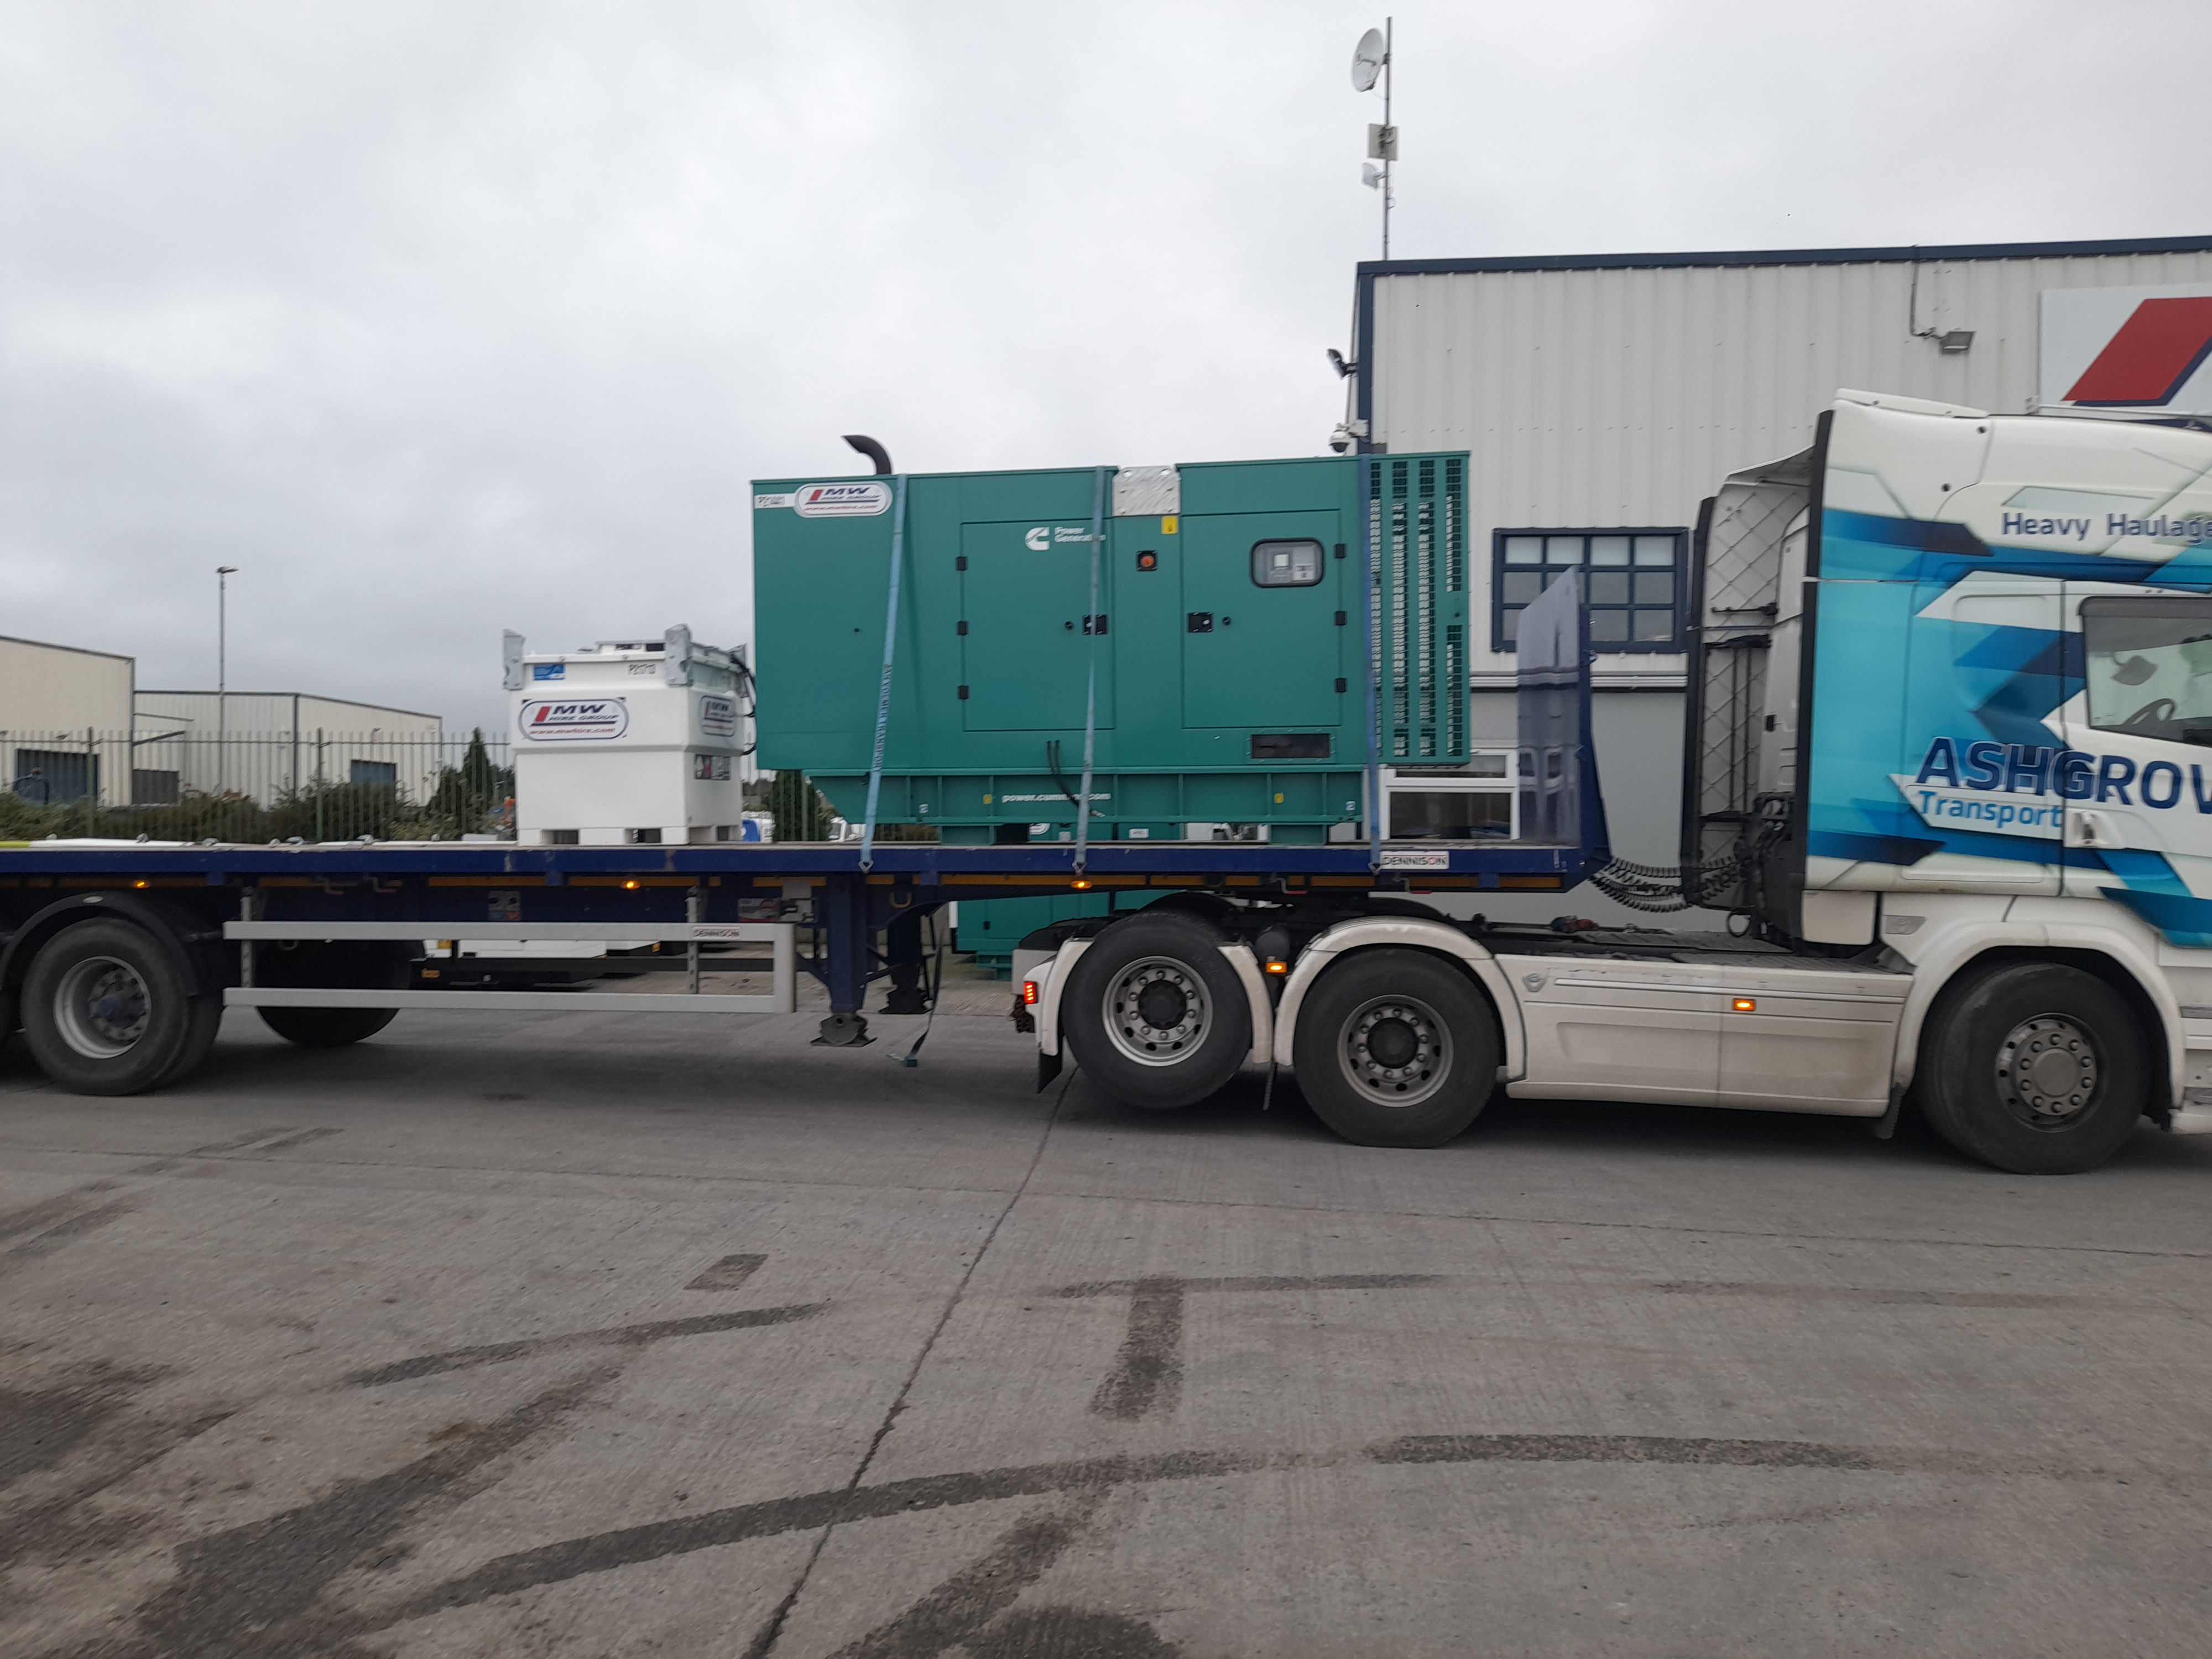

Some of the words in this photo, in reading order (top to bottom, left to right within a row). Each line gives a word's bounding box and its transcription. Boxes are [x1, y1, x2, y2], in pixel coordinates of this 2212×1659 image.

[824, 487, 871, 495] MW
[1054, 526, 1086, 535] Power
[2001, 512, 2091, 541] Heavy
[1054, 533, 1107, 542] Generatn
[552, 704, 607, 714] MW
[1918, 790, 2063, 828] Transport
[1383, 857, 1448, 865] DENNISON
